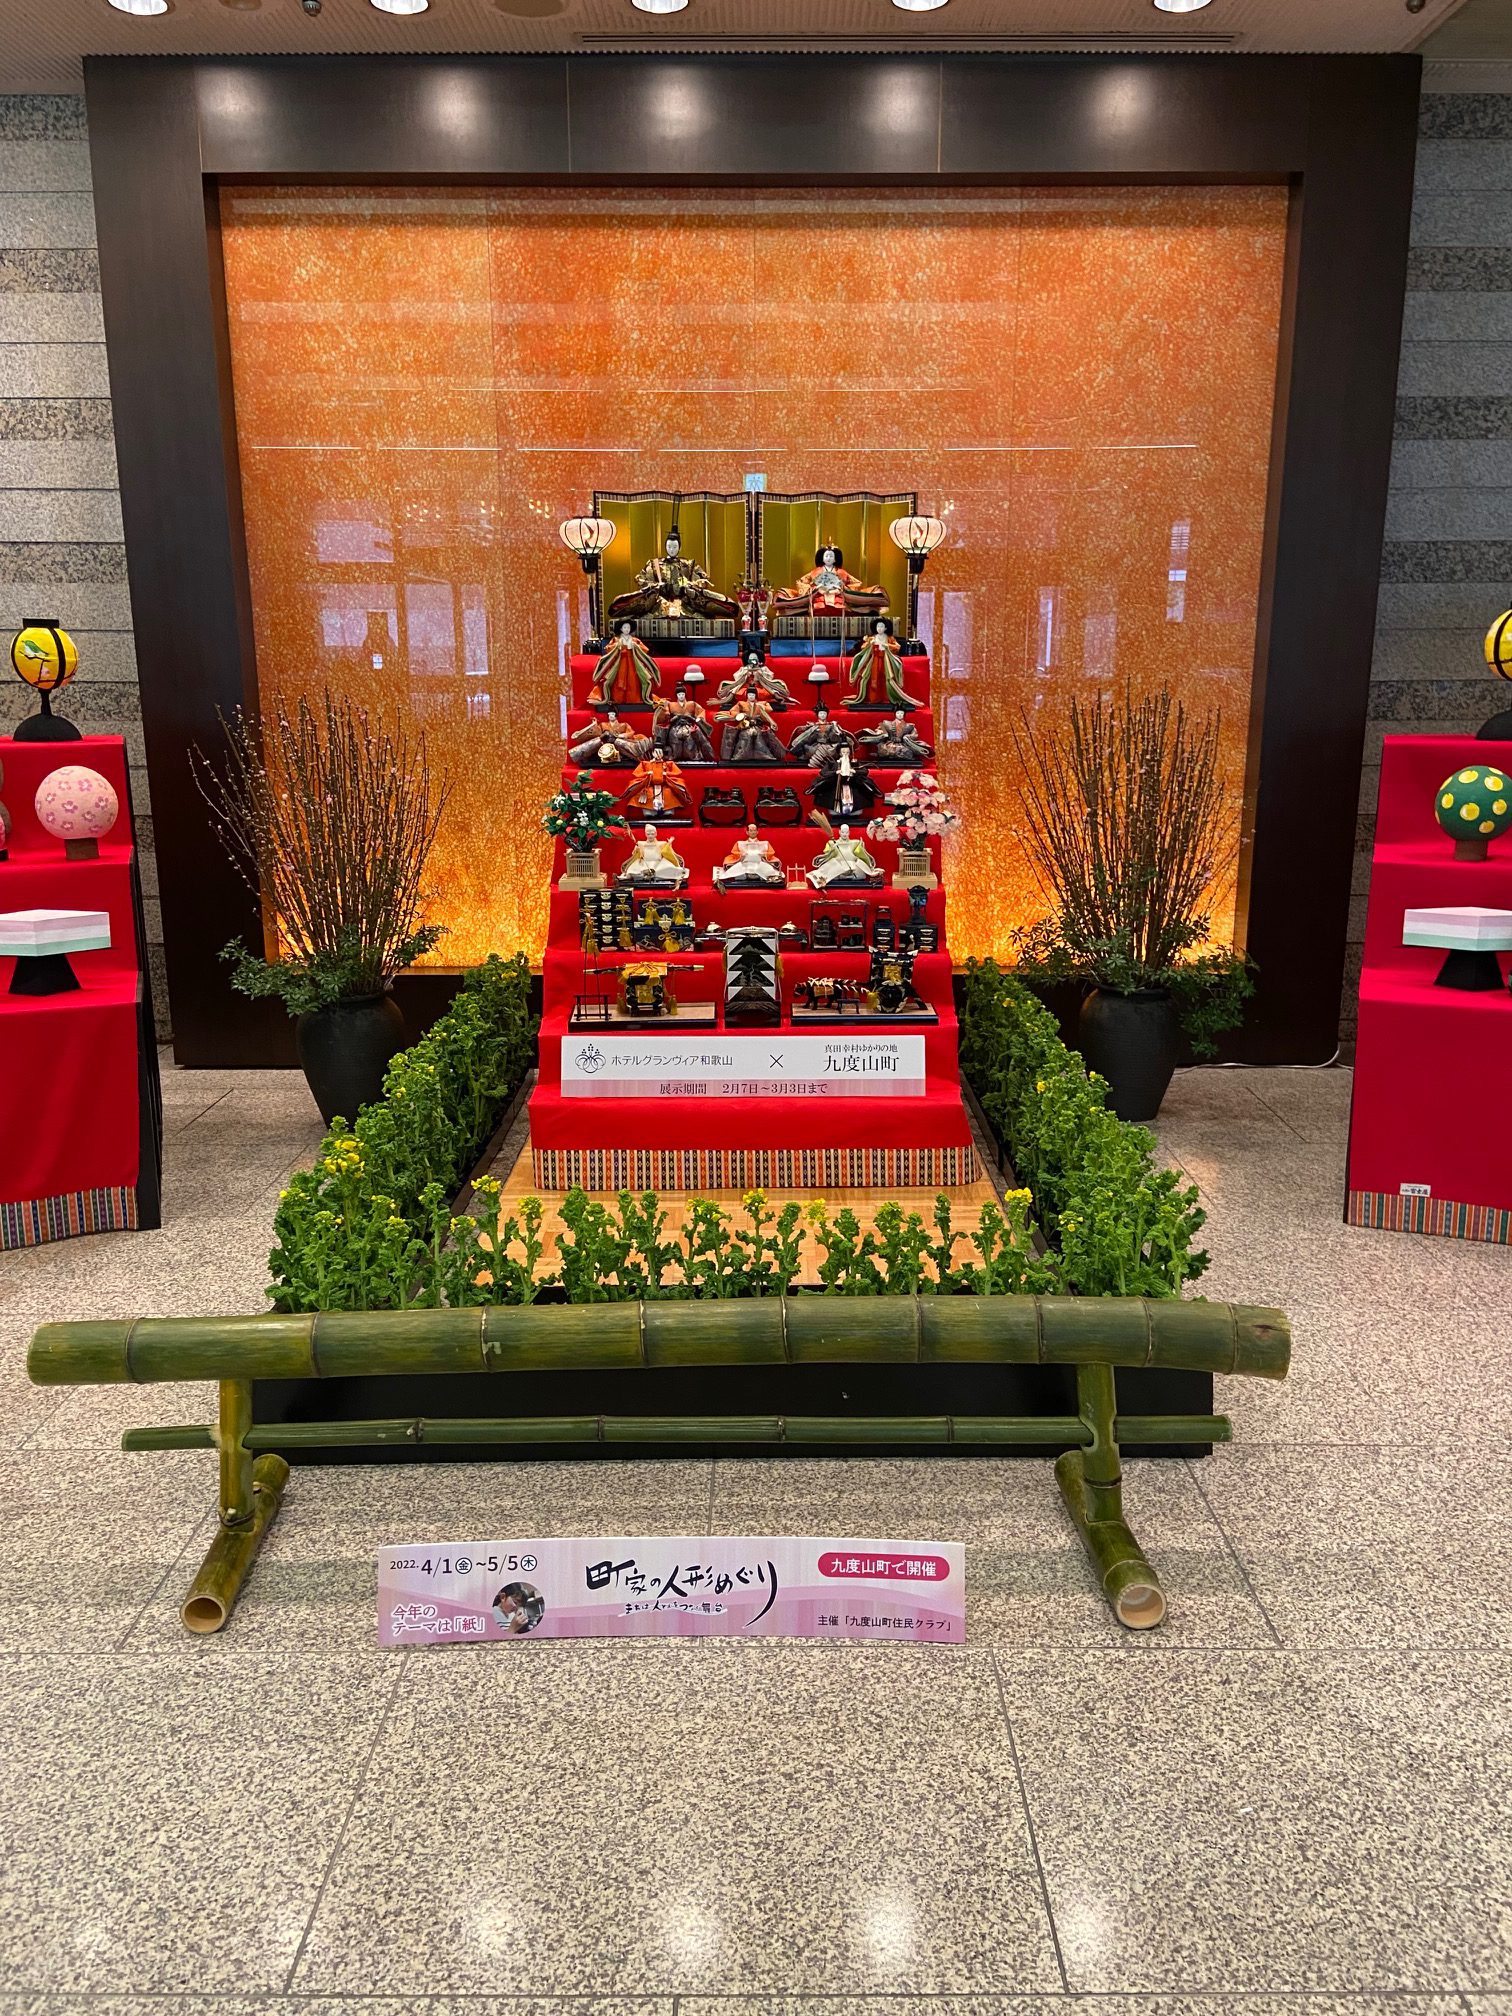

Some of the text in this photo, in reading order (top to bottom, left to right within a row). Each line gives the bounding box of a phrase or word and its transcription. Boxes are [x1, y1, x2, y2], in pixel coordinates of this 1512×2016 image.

[824, 1043, 899, 1053] 真田幸村ゆかりの地
[611, 1055, 733, 1066] ホテルグランヴィア和歌山
[823, 1055, 900, 1072] 九度山町
[660, 1083, 828, 1095] 展示期間 2月7日～3月3日まで
[831, 1558, 937, 1577] 九度山町で開催
[585, 1559, 779, 1627] 町家の人形めぐり
[392, 1604, 437, 1620] 今年の
[392, 1617, 486, 1635] テーマは「紙」
[818, 1615, 951, 1632] 主催「九度山町住民クラブ」
